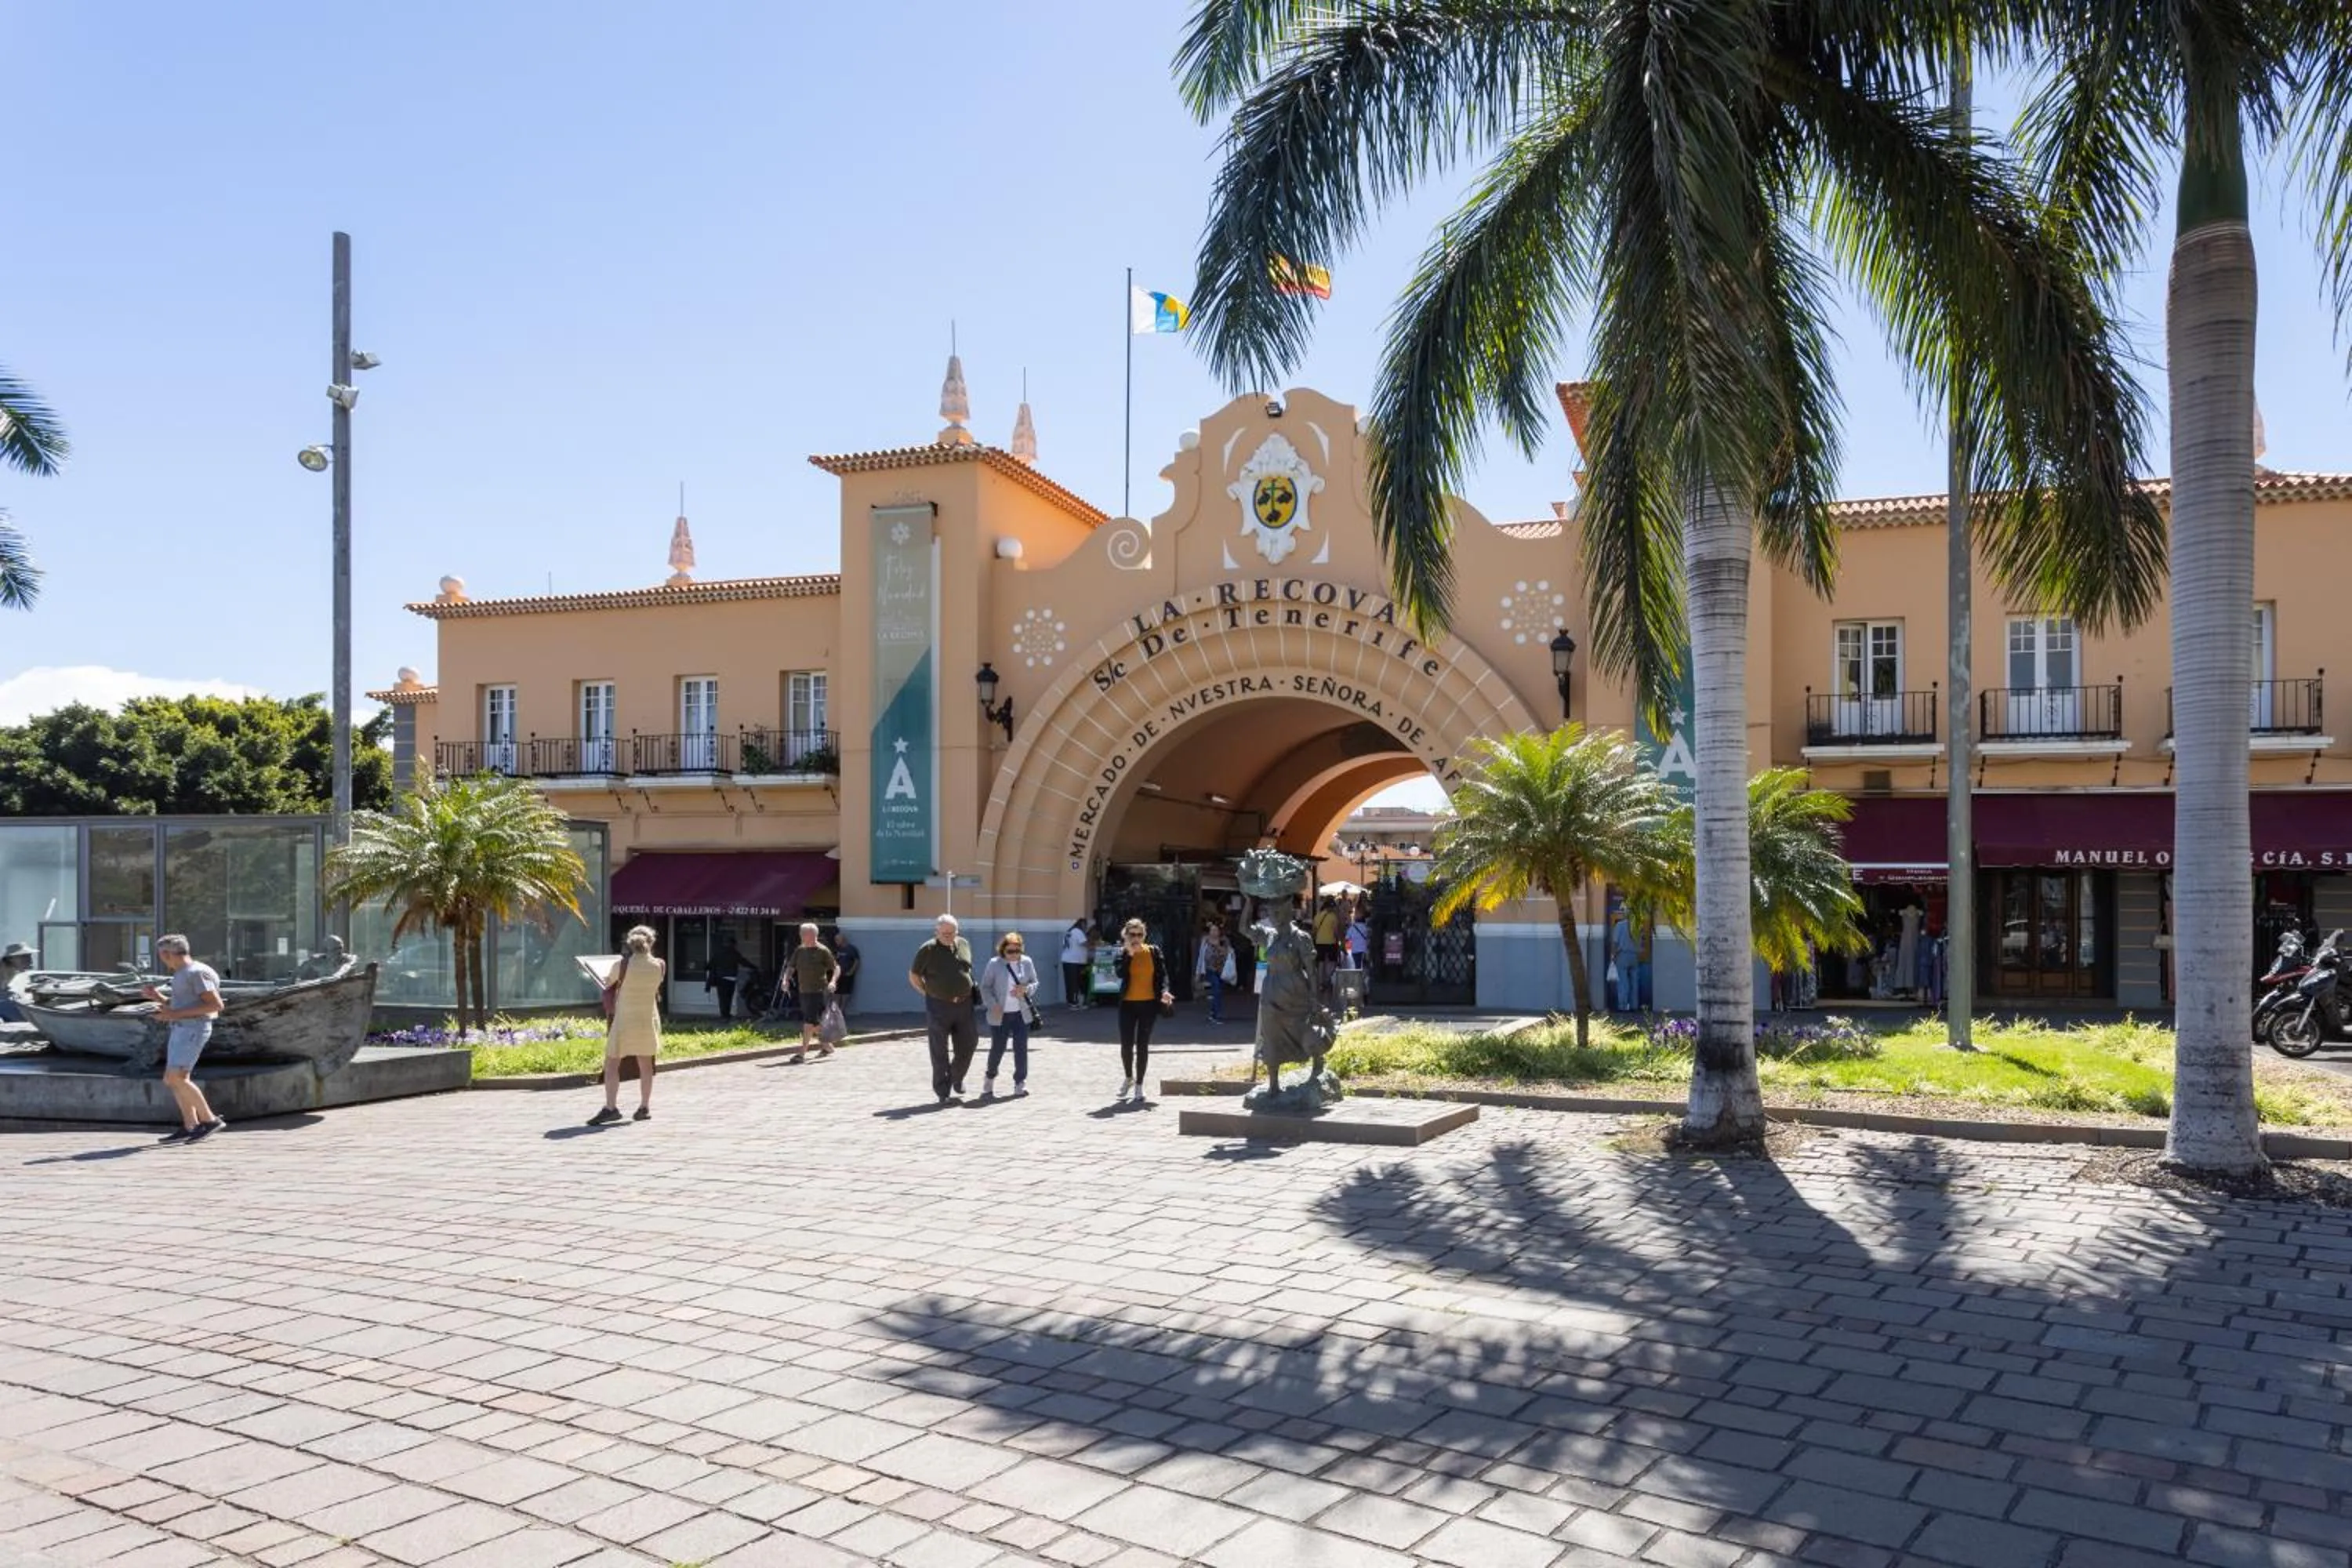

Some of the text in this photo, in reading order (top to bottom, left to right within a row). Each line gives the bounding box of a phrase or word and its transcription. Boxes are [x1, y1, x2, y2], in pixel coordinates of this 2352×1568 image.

[1132, 579, 1394, 635] LA RECOVA
[1093, 605, 1439, 692] S/c De Tenerife
[884, 756, 916, 800] A
[1069, 674, 1463, 859] MERCADO DE NVESTRA SEÑORA DE AF
[1658, 729, 1696, 779] A
[2055, 850, 2148, 864] MANUEL
